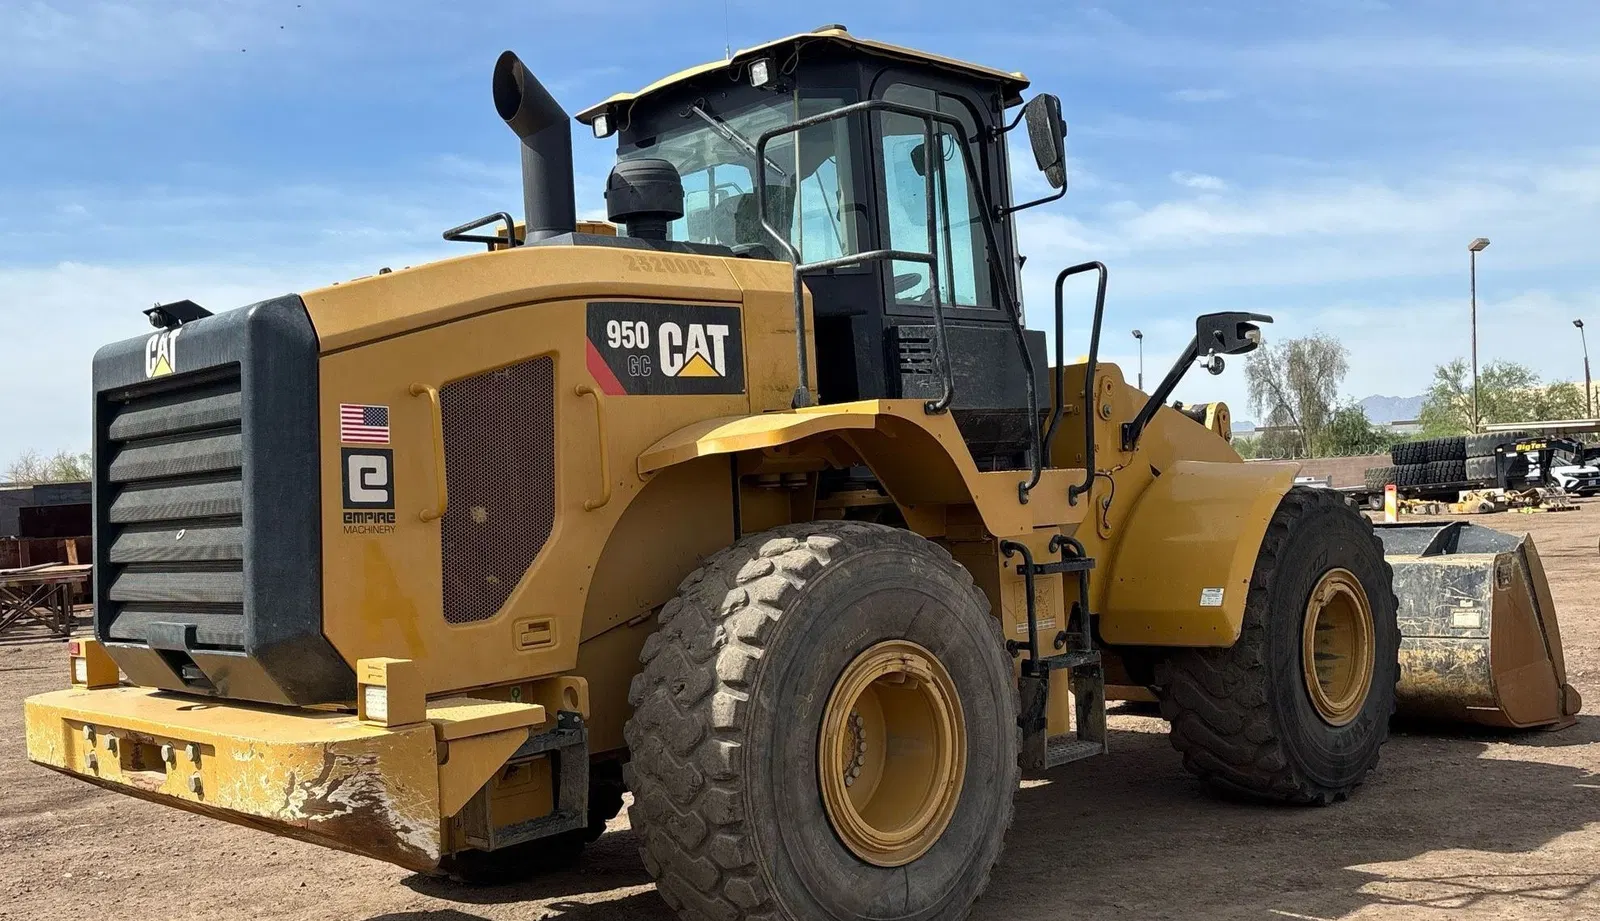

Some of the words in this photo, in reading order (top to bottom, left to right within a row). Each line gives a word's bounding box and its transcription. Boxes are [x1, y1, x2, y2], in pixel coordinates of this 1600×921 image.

[146, 328, 182, 378] CAT
[606, 320, 650, 349] 950
[658, 322, 728, 377] CAT
[627, 355, 651, 376] GC
[343, 525, 395, 534] MACHINERY
